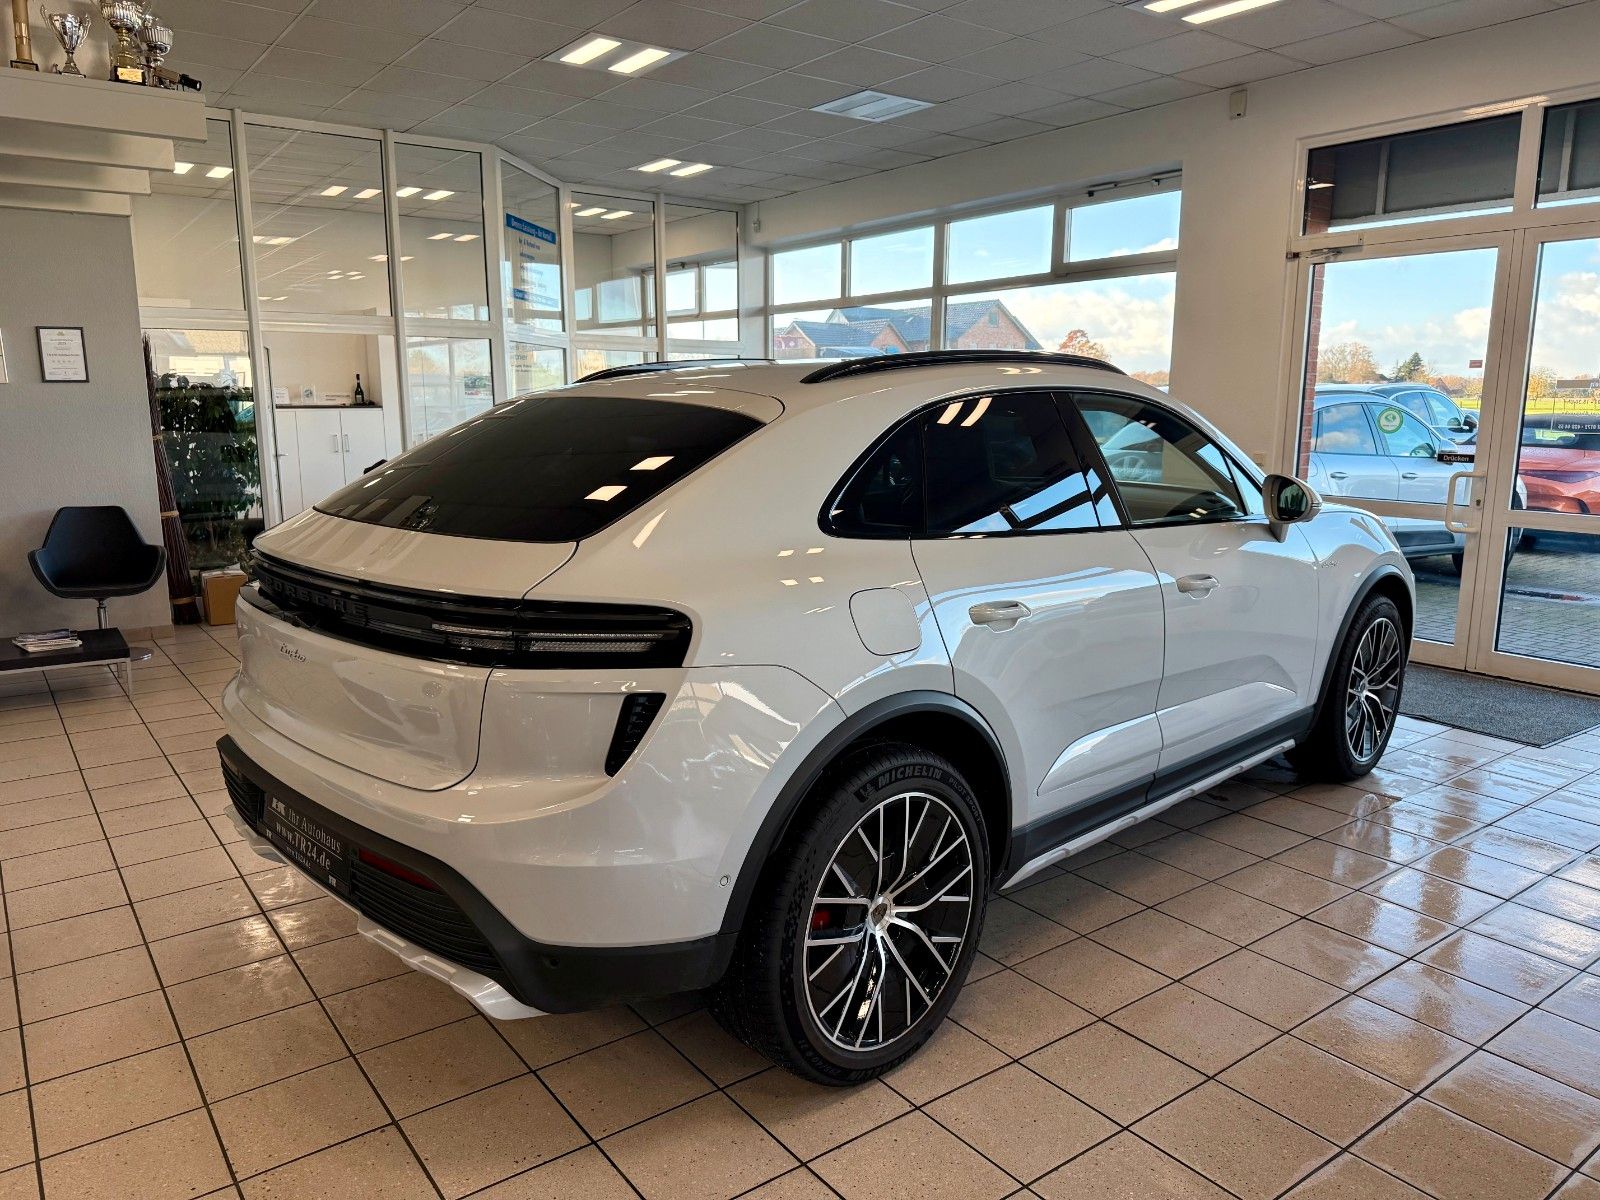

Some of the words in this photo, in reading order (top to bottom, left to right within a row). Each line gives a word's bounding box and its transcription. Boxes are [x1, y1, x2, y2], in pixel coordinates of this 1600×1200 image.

[263, 576, 369, 616] PORSCHE
[878, 765, 942, 789] MICHELIN
[276, 822, 331, 870] www.TR24.de
[288, 808, 300, 825] Ihr
[302, 817, 341, 853] Autohaus
